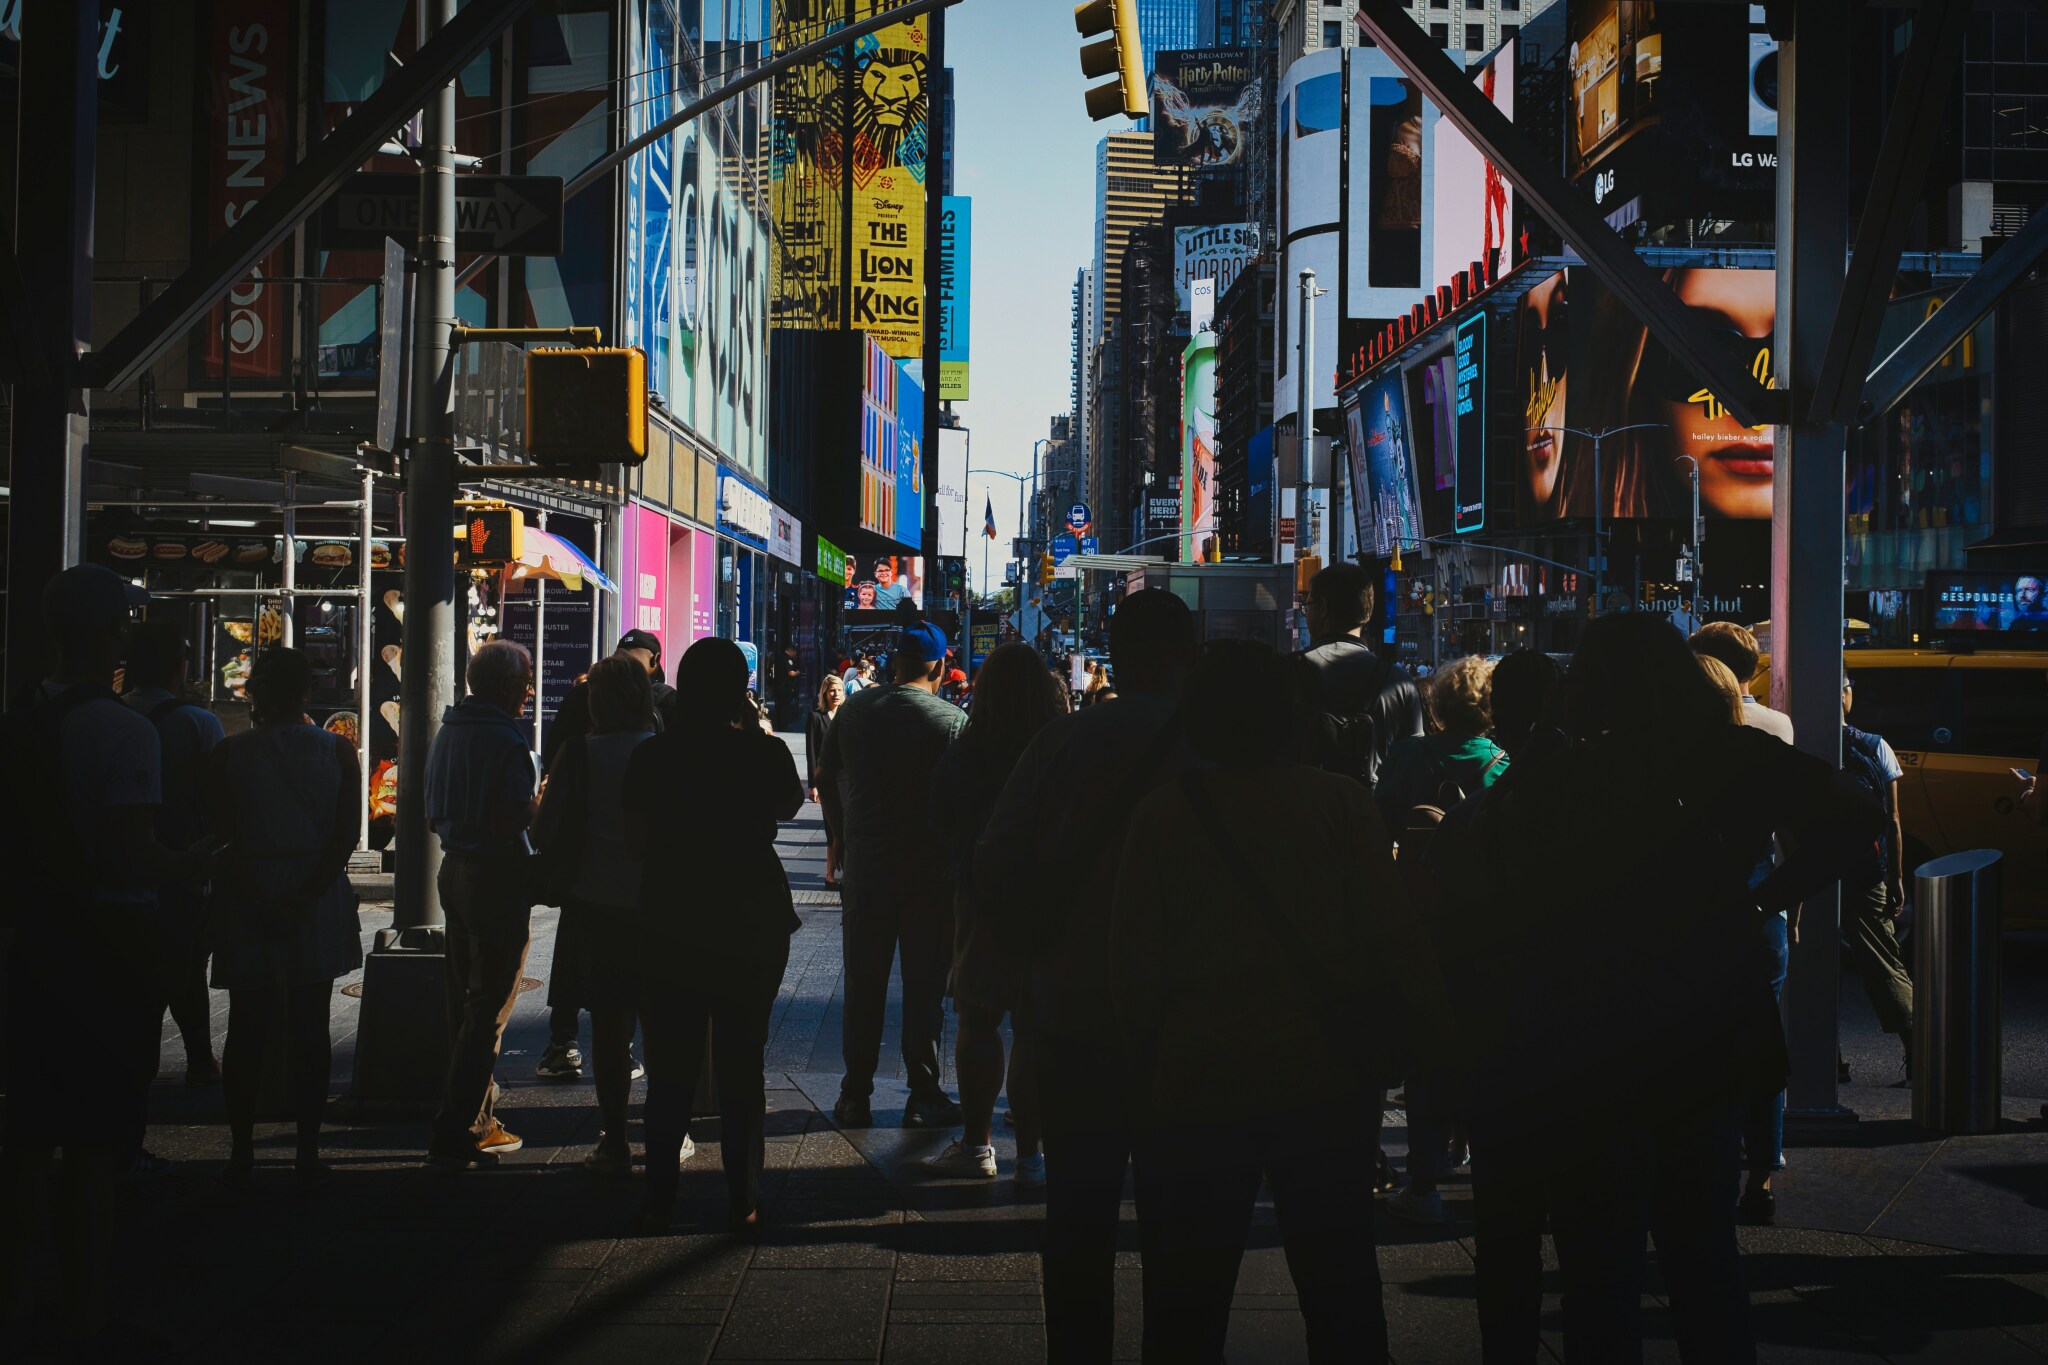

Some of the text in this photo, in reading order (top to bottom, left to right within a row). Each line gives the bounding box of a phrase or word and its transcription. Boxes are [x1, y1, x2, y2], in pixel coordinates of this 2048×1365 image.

[1177, 62, 1251, 88] Harry Potter
[226, 22, 268, 188] NEWS
[1732, 152, 1753, 167] LG
[1604, 169, 1615, 195] LG
[356, 198, 524, 230] ONE WAY
[868, 221, 908, 242] THE
[1185, 227, 1231, 256] LITTLE
[940, 208, 956, 301] FAMILIES
[860, 249, 914, 283] LION
[1194, 286, 1211, 296] COS
[853, 286, 919, 324] KING
[1351, 249, 1496, 377] 1540 BROADWAY
[866, 328, 920, 337] AWARD-WINNING
[1692, 432, 1715, 442] hailey
[1717, 432, 1741, 441] bieber
[1149, 498, 1181, 507] EVERY
[1149, 506, 1177, 515] HERO
[1713, 594, 1743, 613] hut
[1941, 592, 2014, 602] RESPONDER
[513, 623, 533, 631] ARIEL
